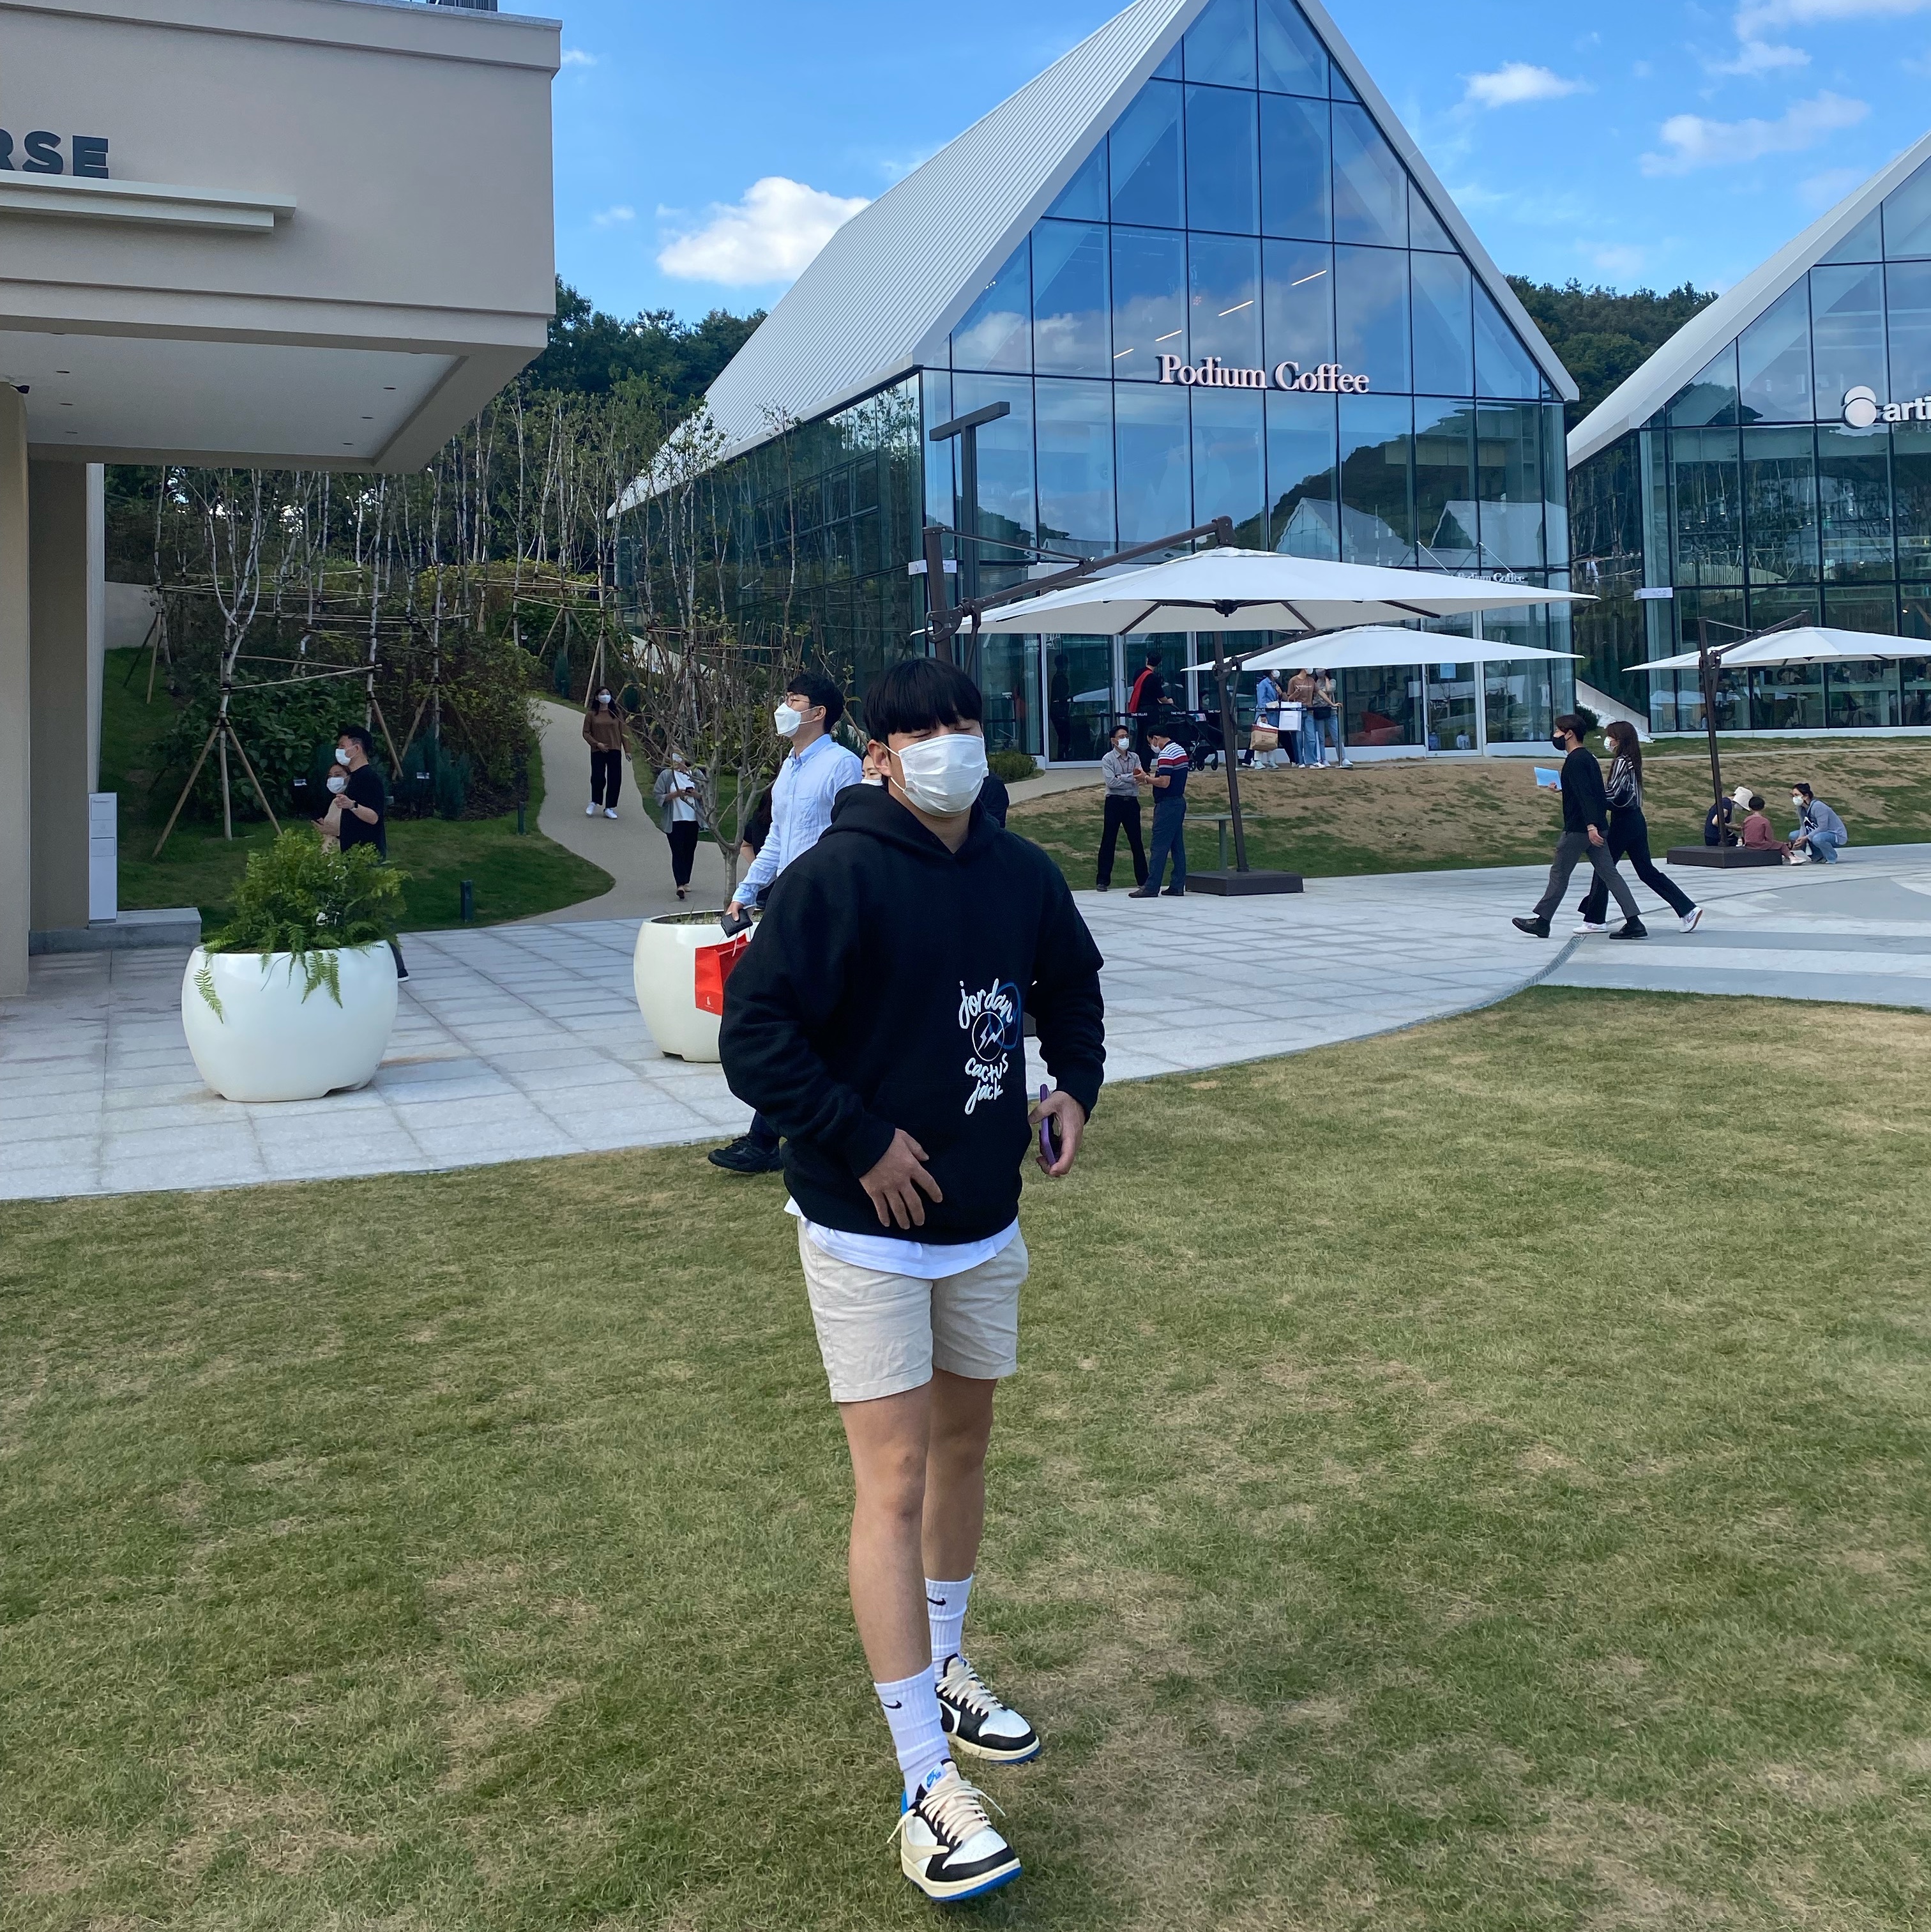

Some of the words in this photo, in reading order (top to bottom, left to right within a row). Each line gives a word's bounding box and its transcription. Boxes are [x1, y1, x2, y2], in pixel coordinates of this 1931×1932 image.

[1156, 353, 1268, 388] Podium
[1274, 361, 1370, 393] Coffee
[1493, 572, 1525, 582] Coffee
[958, 978, 1013, 1030] jordan
